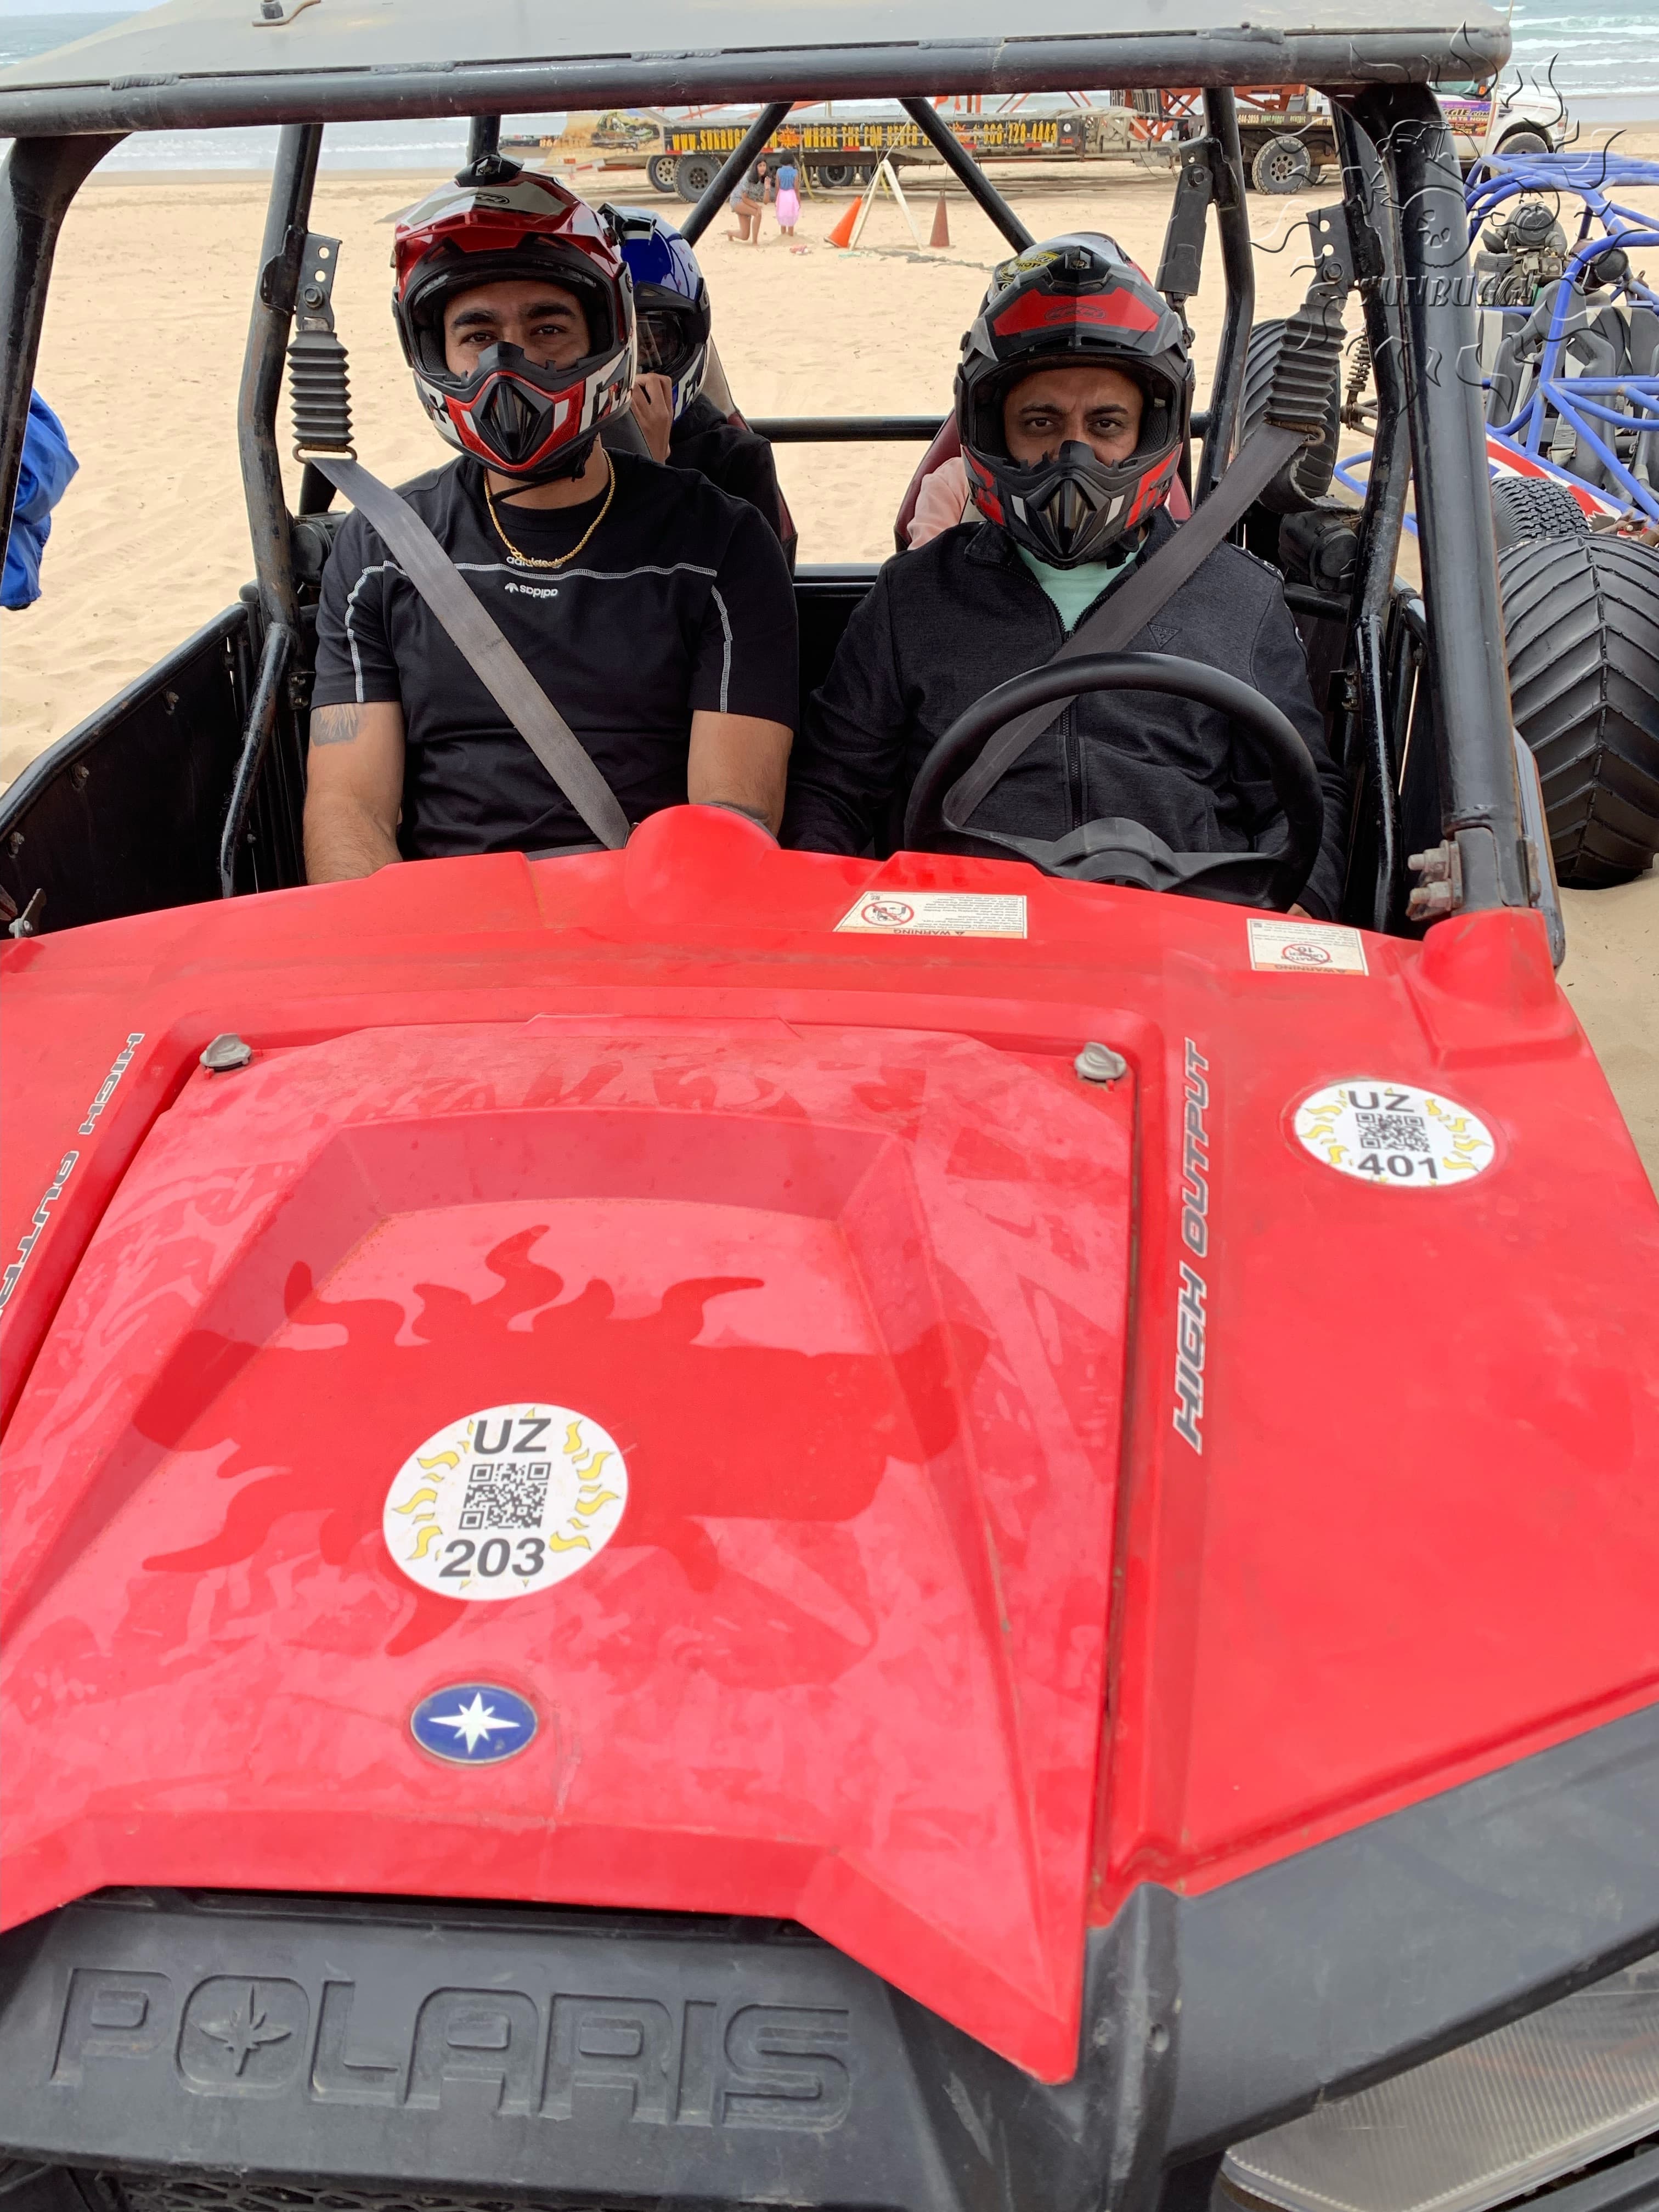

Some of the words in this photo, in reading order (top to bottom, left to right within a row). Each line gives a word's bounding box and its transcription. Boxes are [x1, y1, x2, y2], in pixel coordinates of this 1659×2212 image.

[804, 127, 838, 148] WHERE
[841, 126, 860, 147] THE
[864, 126, 882, 146] FUN
[519, 584, 558, 599] adidas
[1274, 964, 1335, 973] WARNING
[78, 1033, 145, 1135] HIGH
[1348, 1090, 1415, 1113] UZ
[1182, 1037, 1209, 1258] OUTPUT
[1357, 1153, 1438, 1180] 401
[0, 1150, 79, 1317] OUTP
[1173, 1260, 1206, 1455] HIGH
[473, 1418, 551, 1455] UZ
[438, 1537, 546, 1578] 203
[50, 1967, 853, 2134] POLARIS
